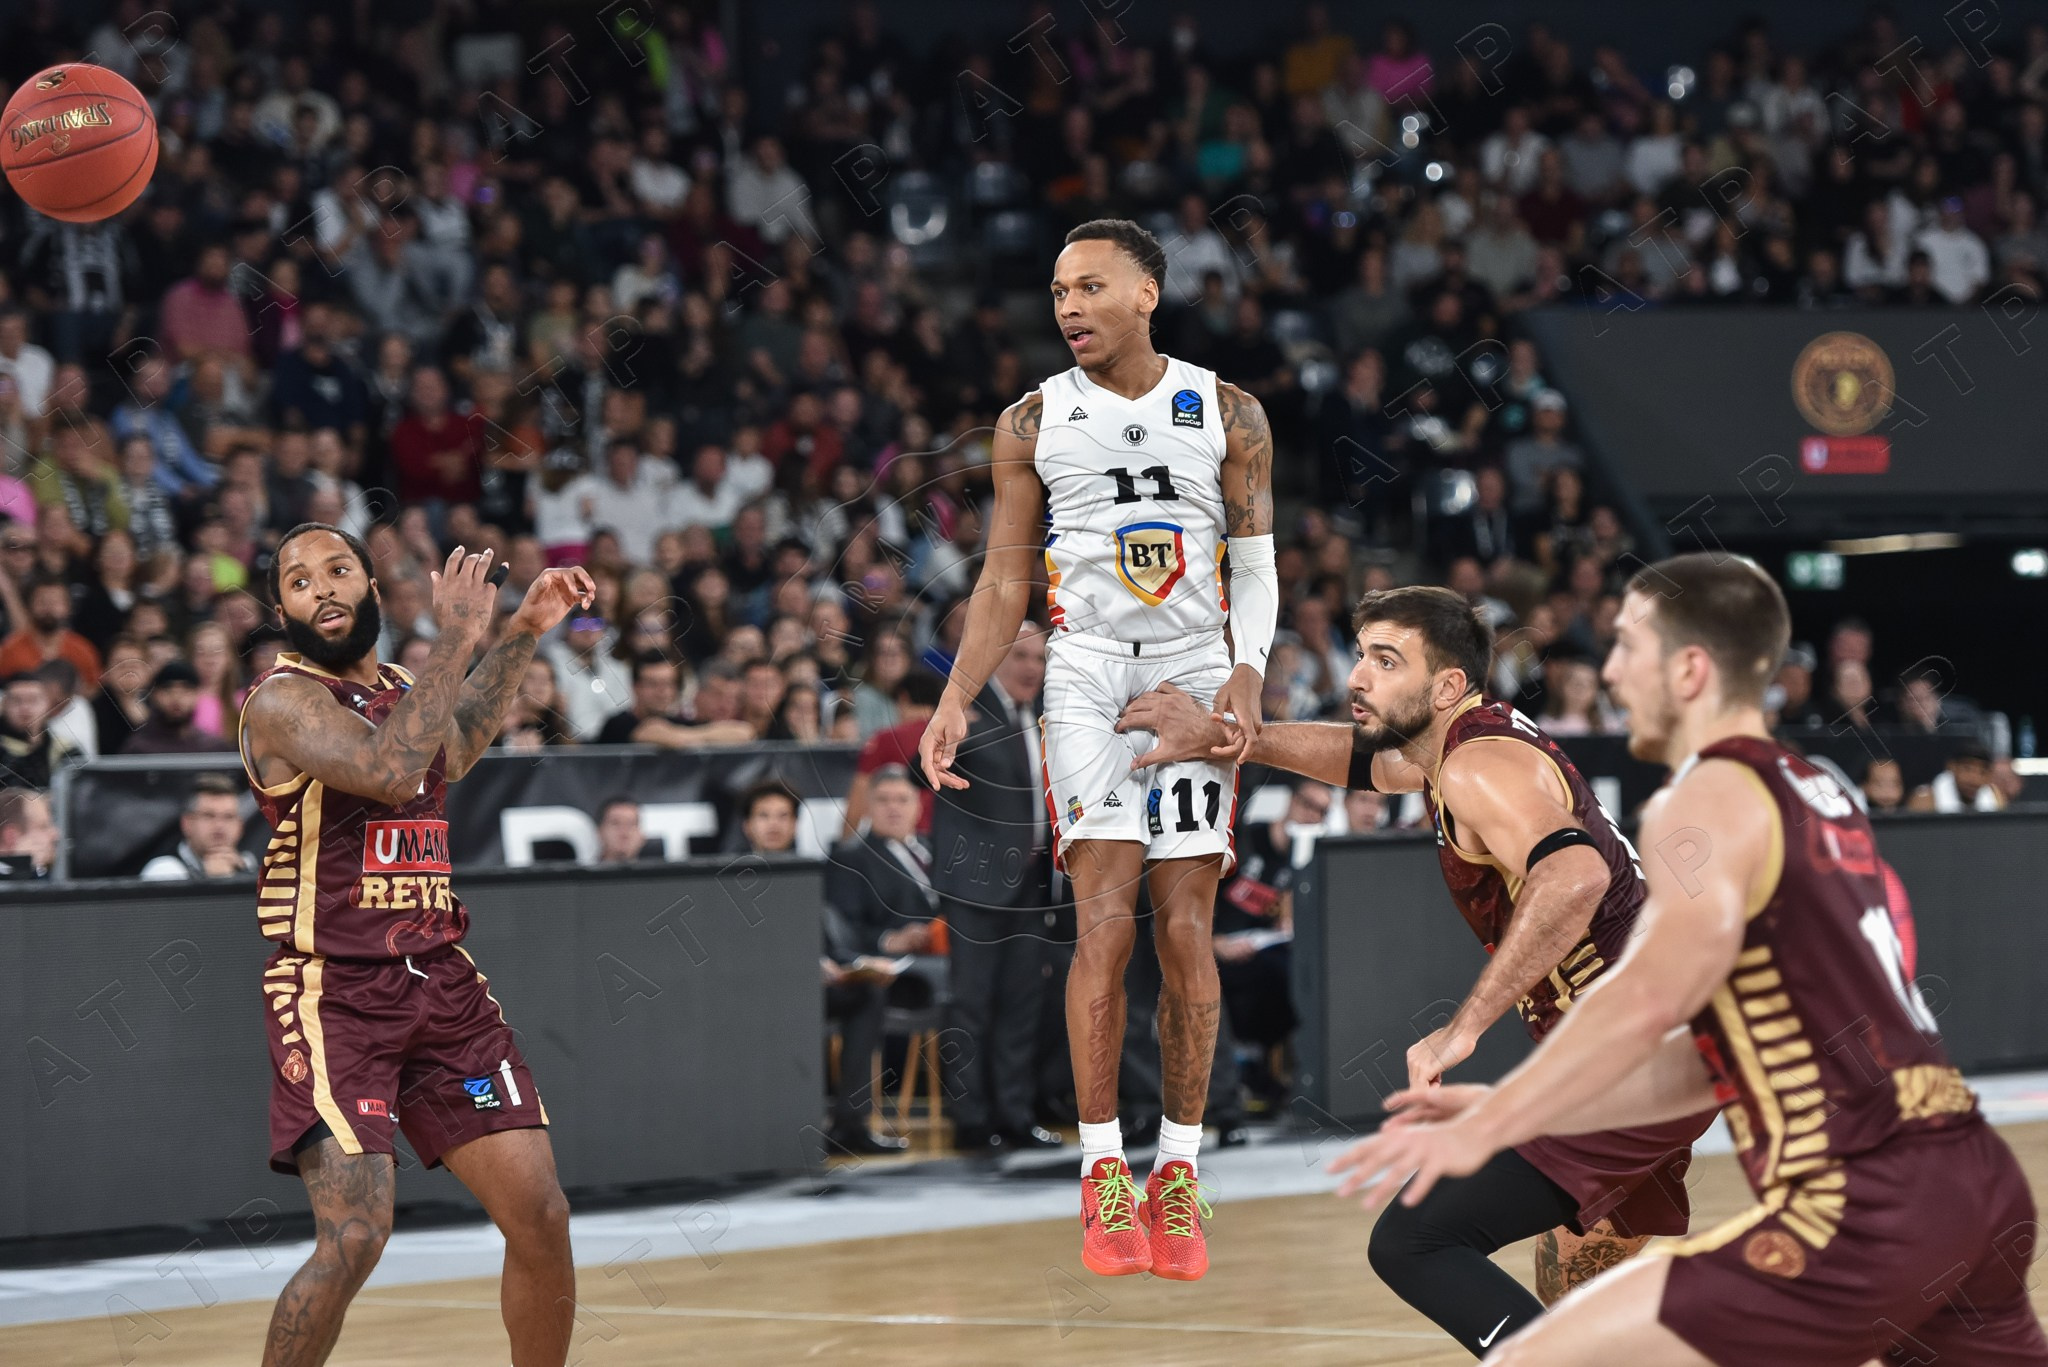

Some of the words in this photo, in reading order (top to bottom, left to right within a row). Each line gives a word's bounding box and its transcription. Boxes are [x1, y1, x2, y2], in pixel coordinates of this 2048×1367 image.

[10, 102, 112, 151] SPALDING
[1068, 413, 1089, 422] PEAK
[1174, 418, 1202, 427] EuroCup
[1104, 466, 1180, 505] 11
[1129, 543, 1172, 568] BT
[1171, 777, 1221, 833] 11
[499, 1059, 522, 1106] 1
